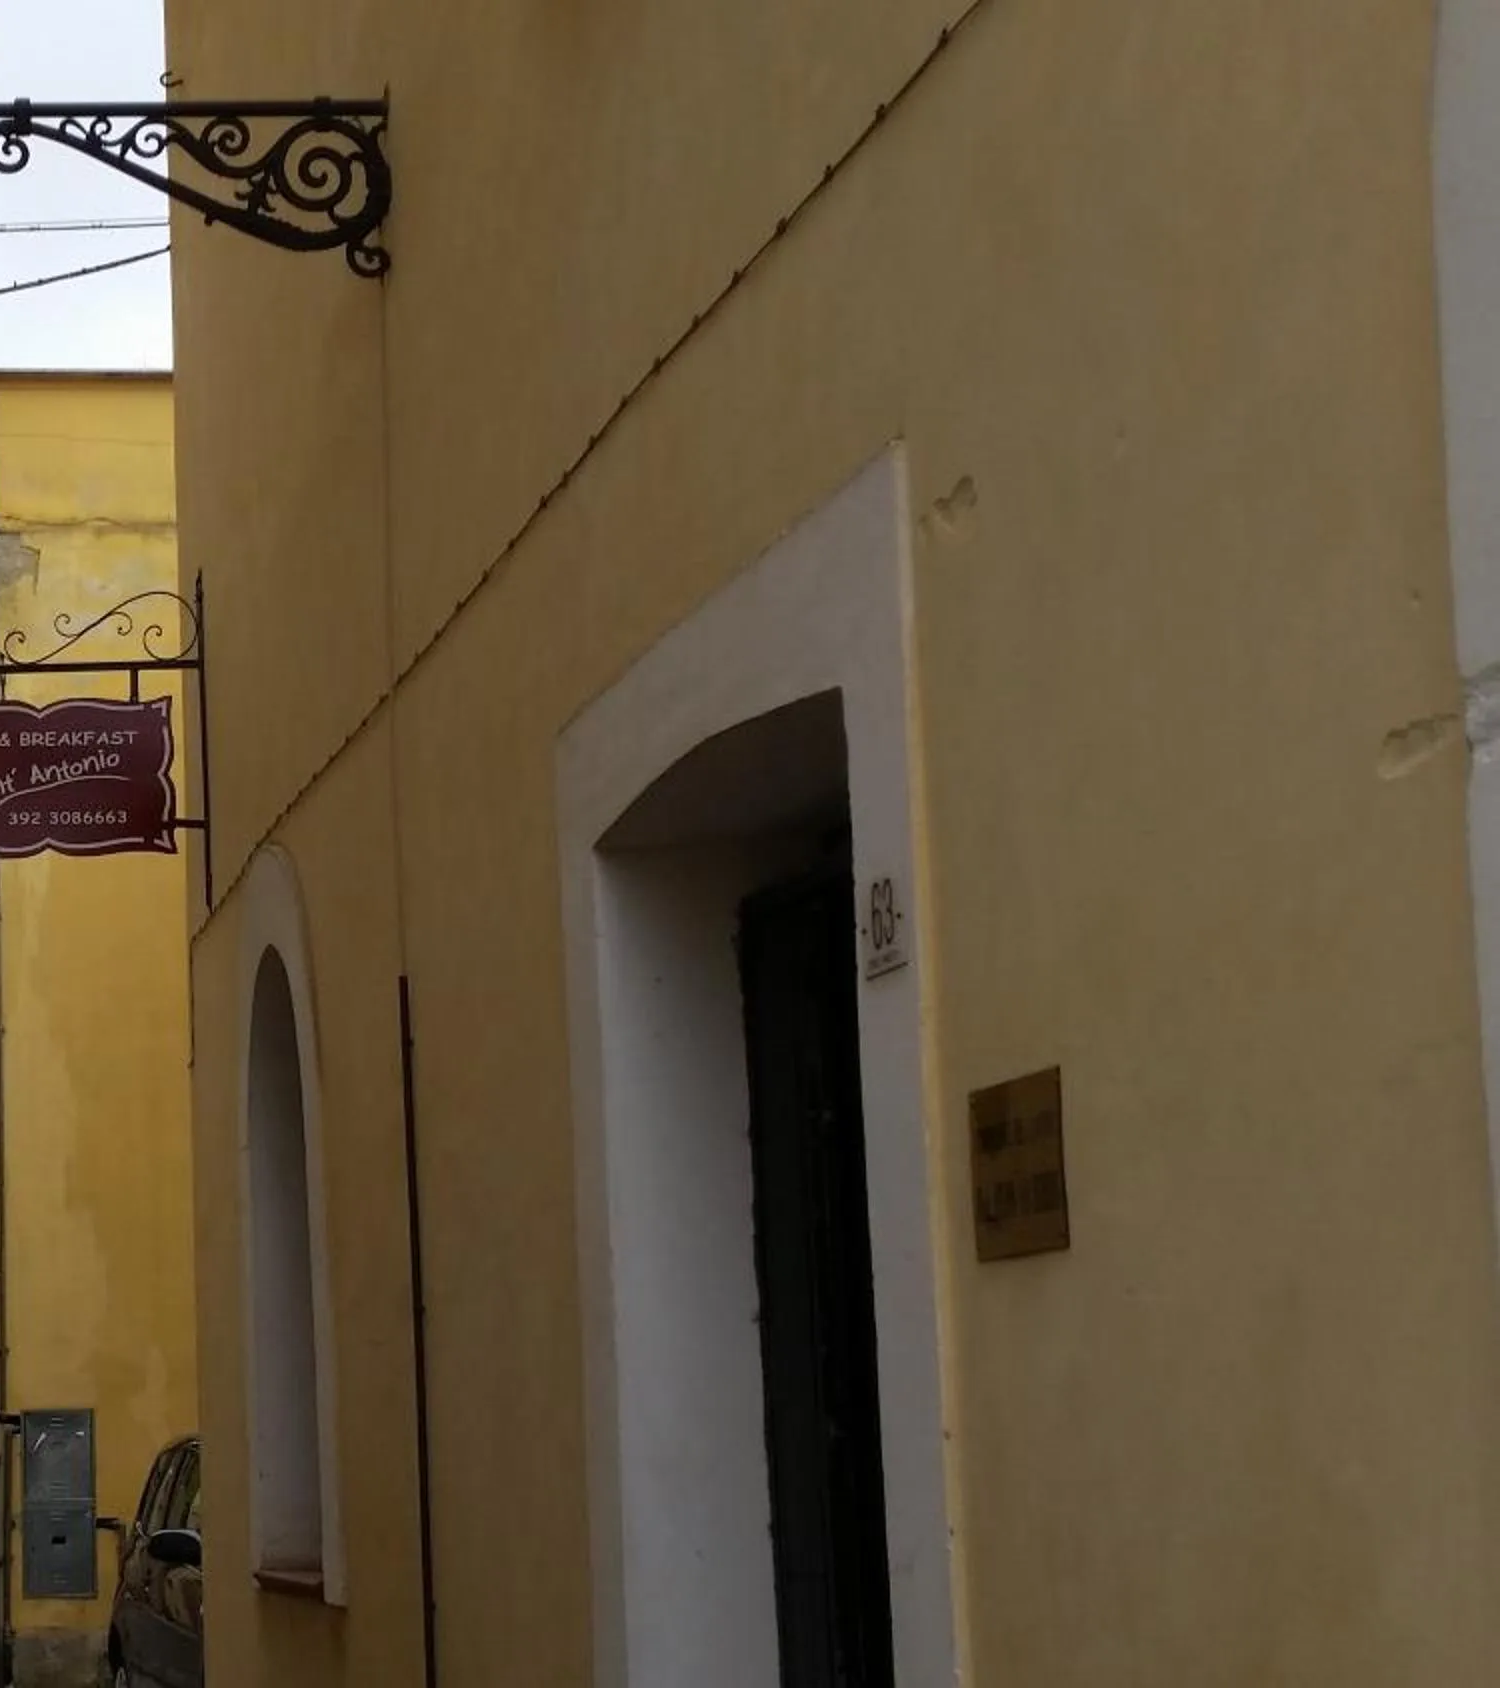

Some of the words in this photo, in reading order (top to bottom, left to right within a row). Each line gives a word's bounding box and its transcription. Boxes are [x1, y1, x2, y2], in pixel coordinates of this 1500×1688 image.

[19, 731, 139, 747] BREAKFAST
[30, 749, 120, 785] Antonio
[7, 812, 41, 826] 392
[50, 811, 128, 825] 3086663
